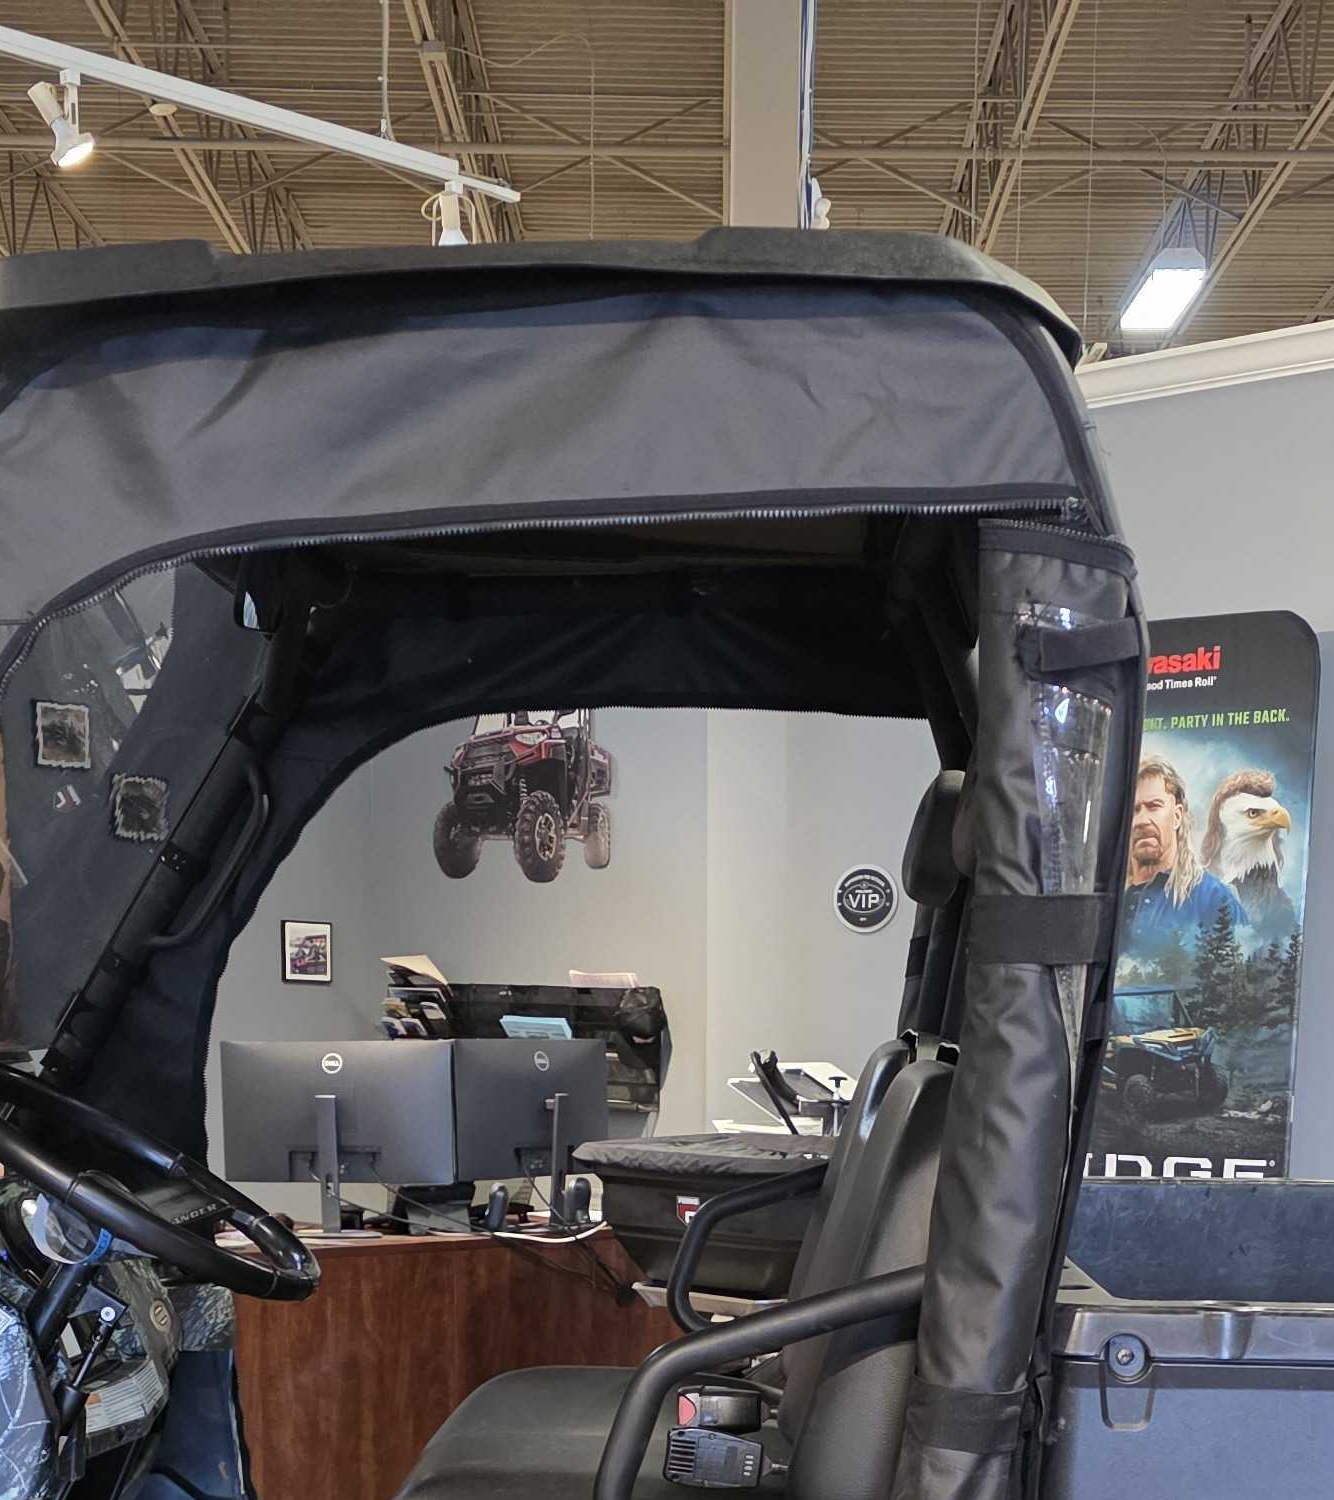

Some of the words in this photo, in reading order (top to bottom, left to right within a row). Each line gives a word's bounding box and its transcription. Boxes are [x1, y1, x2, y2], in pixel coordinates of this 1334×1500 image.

[1165, 678, 1194, 690] Times
[1170, 714, 1210, 729] PARTY
[1212, 712, 1225, 727] IN
[1227, 710, 1250, 726] THE
[1253, 708, 1290, 724] BACK.
[848, 893, 880, 908] VIP
